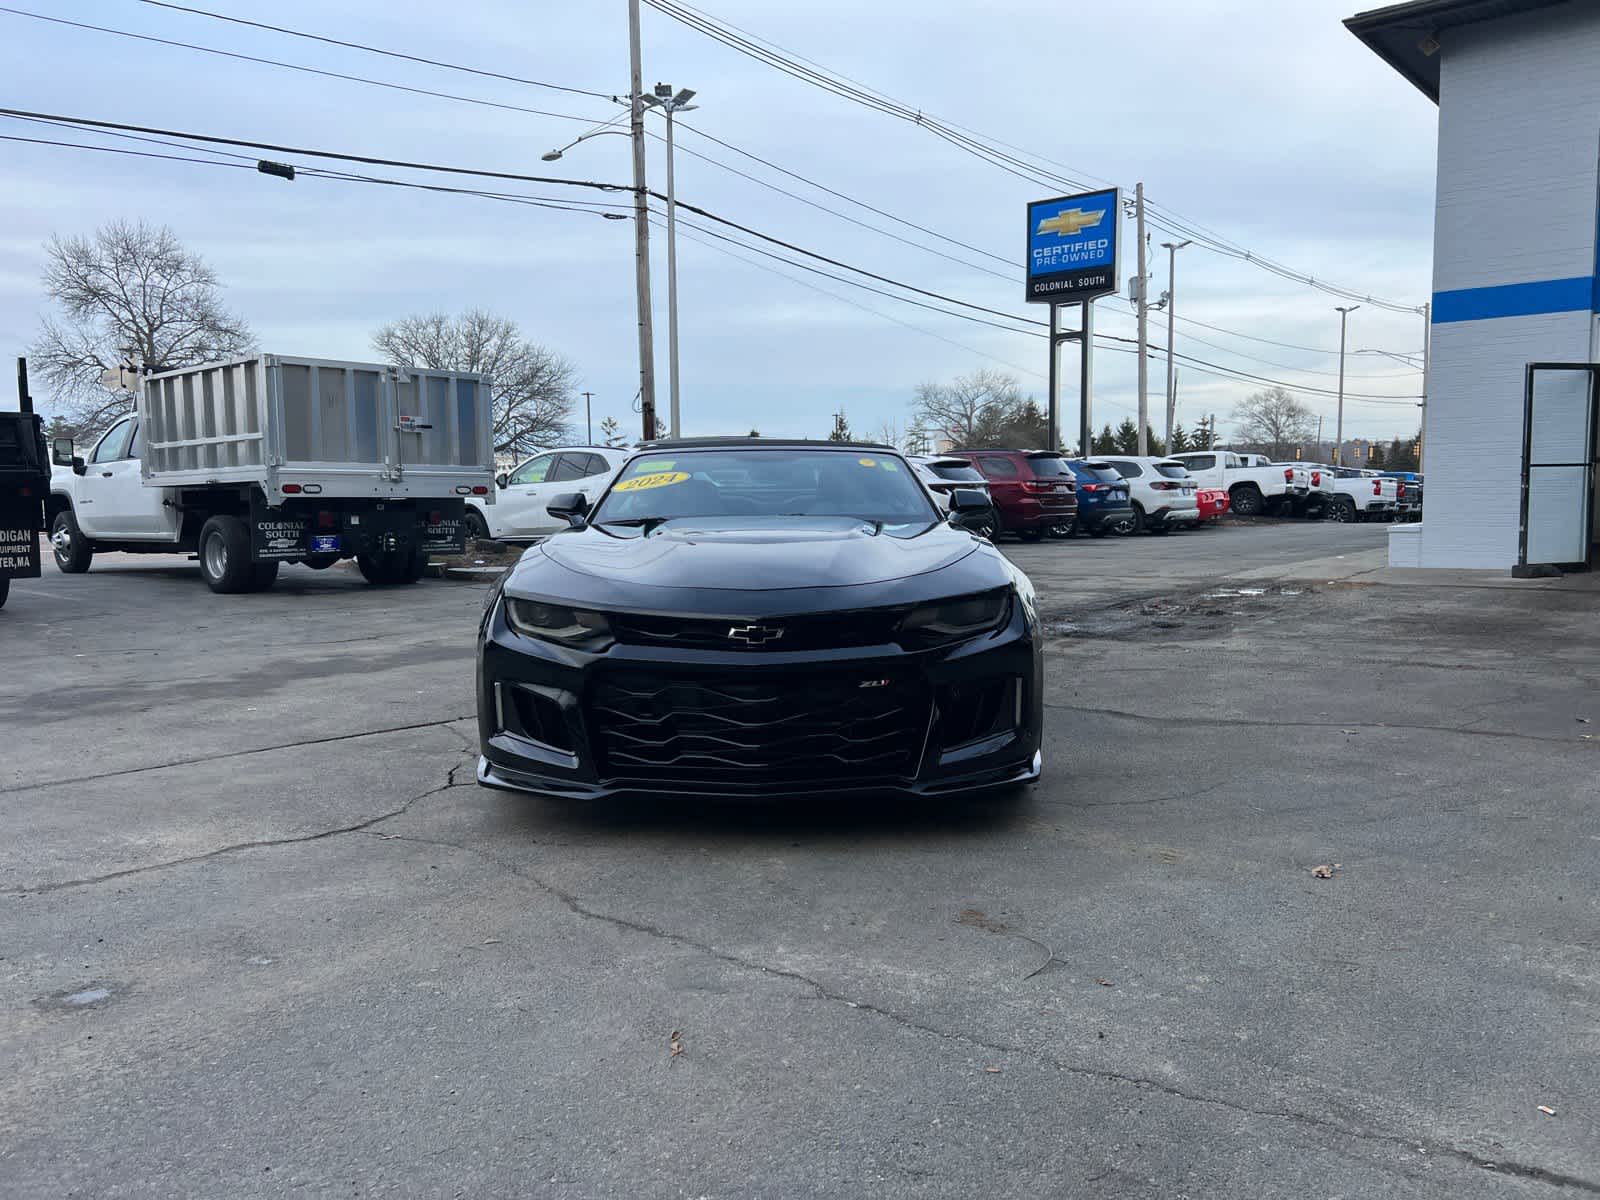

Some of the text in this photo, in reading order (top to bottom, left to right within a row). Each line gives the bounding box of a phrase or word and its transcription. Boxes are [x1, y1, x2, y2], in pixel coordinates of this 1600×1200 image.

[1033, 239, 1108, 258] CERTIFIED
[1036, 249, 1105, 267] PRE-OWNED
[1034, 276, 1105, 292] COLONIAL SOUTH
[257, 521, 304, 530] COLONIAL
[265, 530, 300, 539] SOUTH
